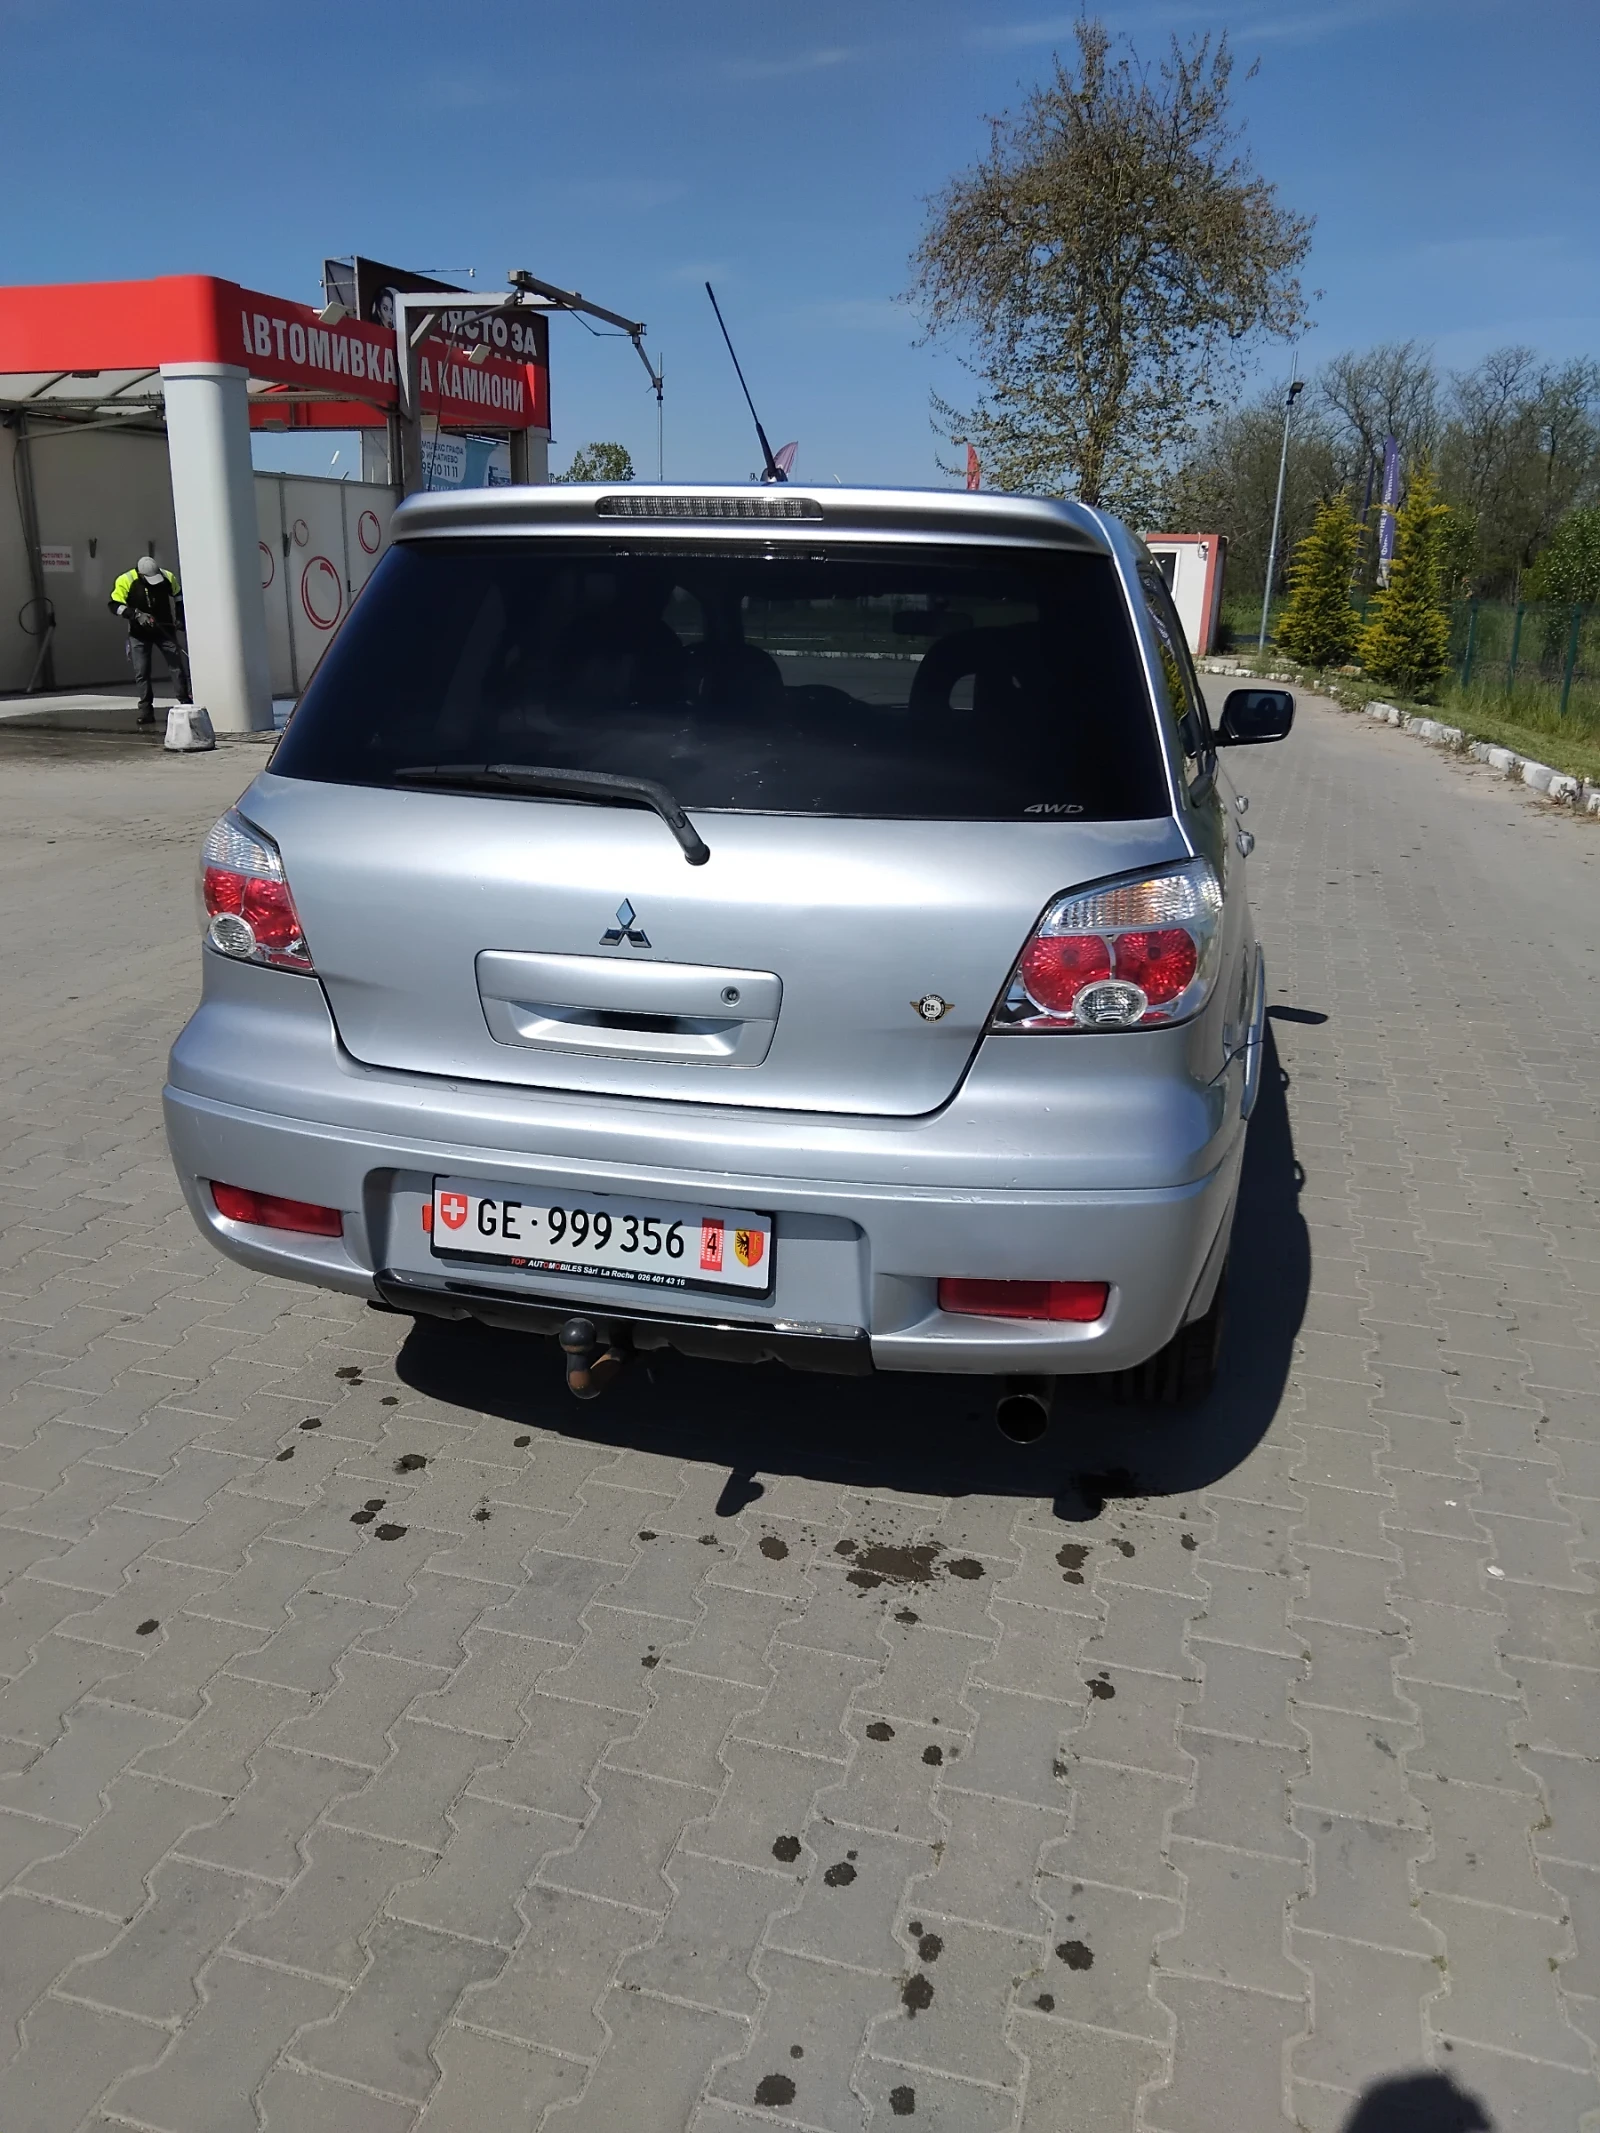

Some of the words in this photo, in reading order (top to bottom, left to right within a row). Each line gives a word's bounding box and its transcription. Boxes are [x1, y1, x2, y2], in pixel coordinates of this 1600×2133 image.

[511, 322, 537, 357] ЗА
[420, 356, 432, 392] А
[438, 361, 524, 412] КАМИОНИ
[1023, 803, 1085, 814] 4WD
[706, 1232, 717, 1256] 4
[510, 1257, 526, 1266] TOP
[528, 1259, 582, 1273] AUTOMOBILES
[611, 1270, 635, 1280] Roche
[637, 1273, 651, 1282] 026
[652, 1275, 664, 1284] 401
[665, 1277, 676, 1285] 43
